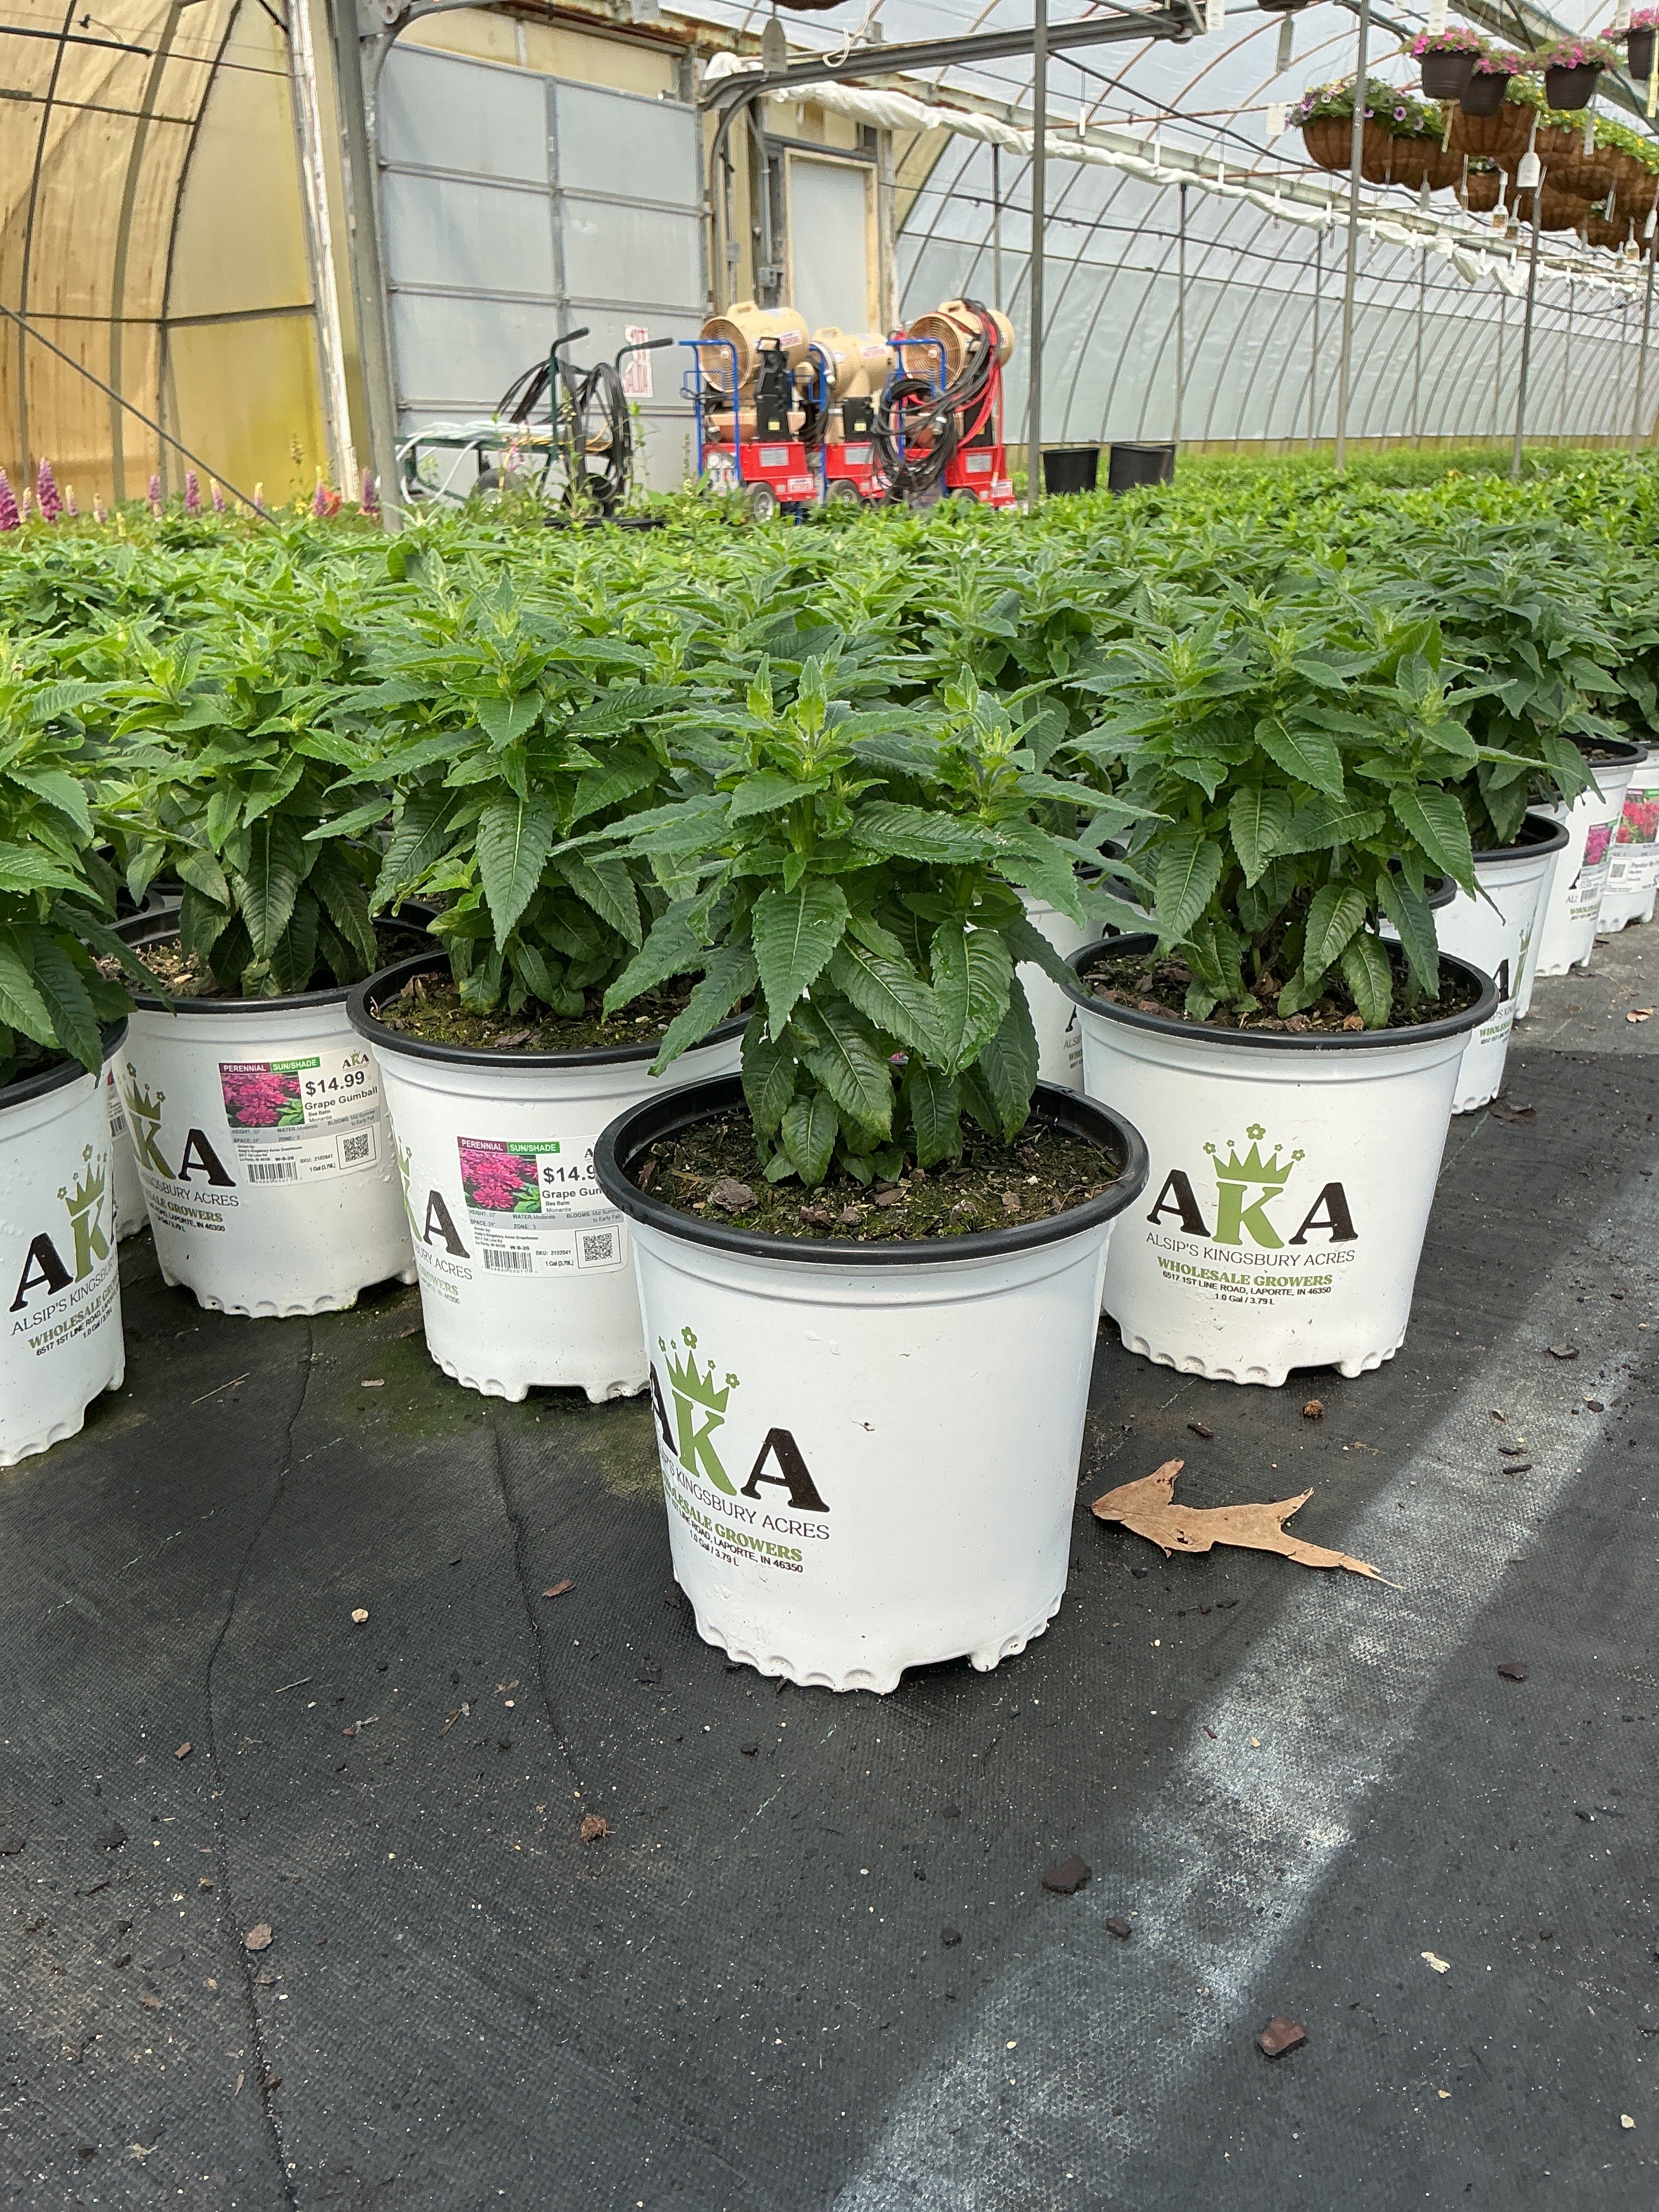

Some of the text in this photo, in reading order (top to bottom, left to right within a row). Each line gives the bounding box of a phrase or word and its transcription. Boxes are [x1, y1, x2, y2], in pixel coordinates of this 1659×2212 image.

[273, 1059, 317, 1071] SUN/SHADE
[342, 1053, 370, 1069] AKA
[306, 1070, 365, 1097] $14.99
[304, 1086, 378, 1111] Grape Gumball
[461, 1139, 557, 1152] PERENNIAL SUN/SHADE
[543, 1164, 596, 1184] $14.9
[194, 1191, 240, 1207] ACRES
[542, 1190, 576, 1200] Grape
[1147, 1169, 1359, 1249] AKA
[1146, 1232, 1355, 1267] ALSIP'S KINGSBURY ACRES
[435, 1257, 472, 1280] ACRES
[1157, 1256, 1333, 1287] WHOLESALE GROWERS
[1163, 1271, 1180, 1281] 6517
[1182, 1276, 1198, 1285] 1ST
[1199, 1281, 1218, 1290] LINE
[1250, 1288, 1295, 1296] LAPORTE,
[1307, 1286, 1331, 1295] 46350
[1249, 1297, 1268, 1305] 3.79
[10, 1298, 67, 1336] ALSIP'S
[27, 1295, 102, 1349] WHOLESALE
[36, 1341, 54, 1356] 6517
[676, 1467, 757, 1525] KINGSBURY
[761, 1515, 830, 1540] ACRES
[699, 1538, 709, 1551] Gal
[715, 1548, 732, 1564] 3.79
[733, 1558, 740, 1567] L
[714, 1523, 803, 1562] GROWERS
[714, 1536, 758, 1563] LAPORTE,
[760, 1555, 771, 1566] IN
[772, 1559, 803, 1573] 46350
